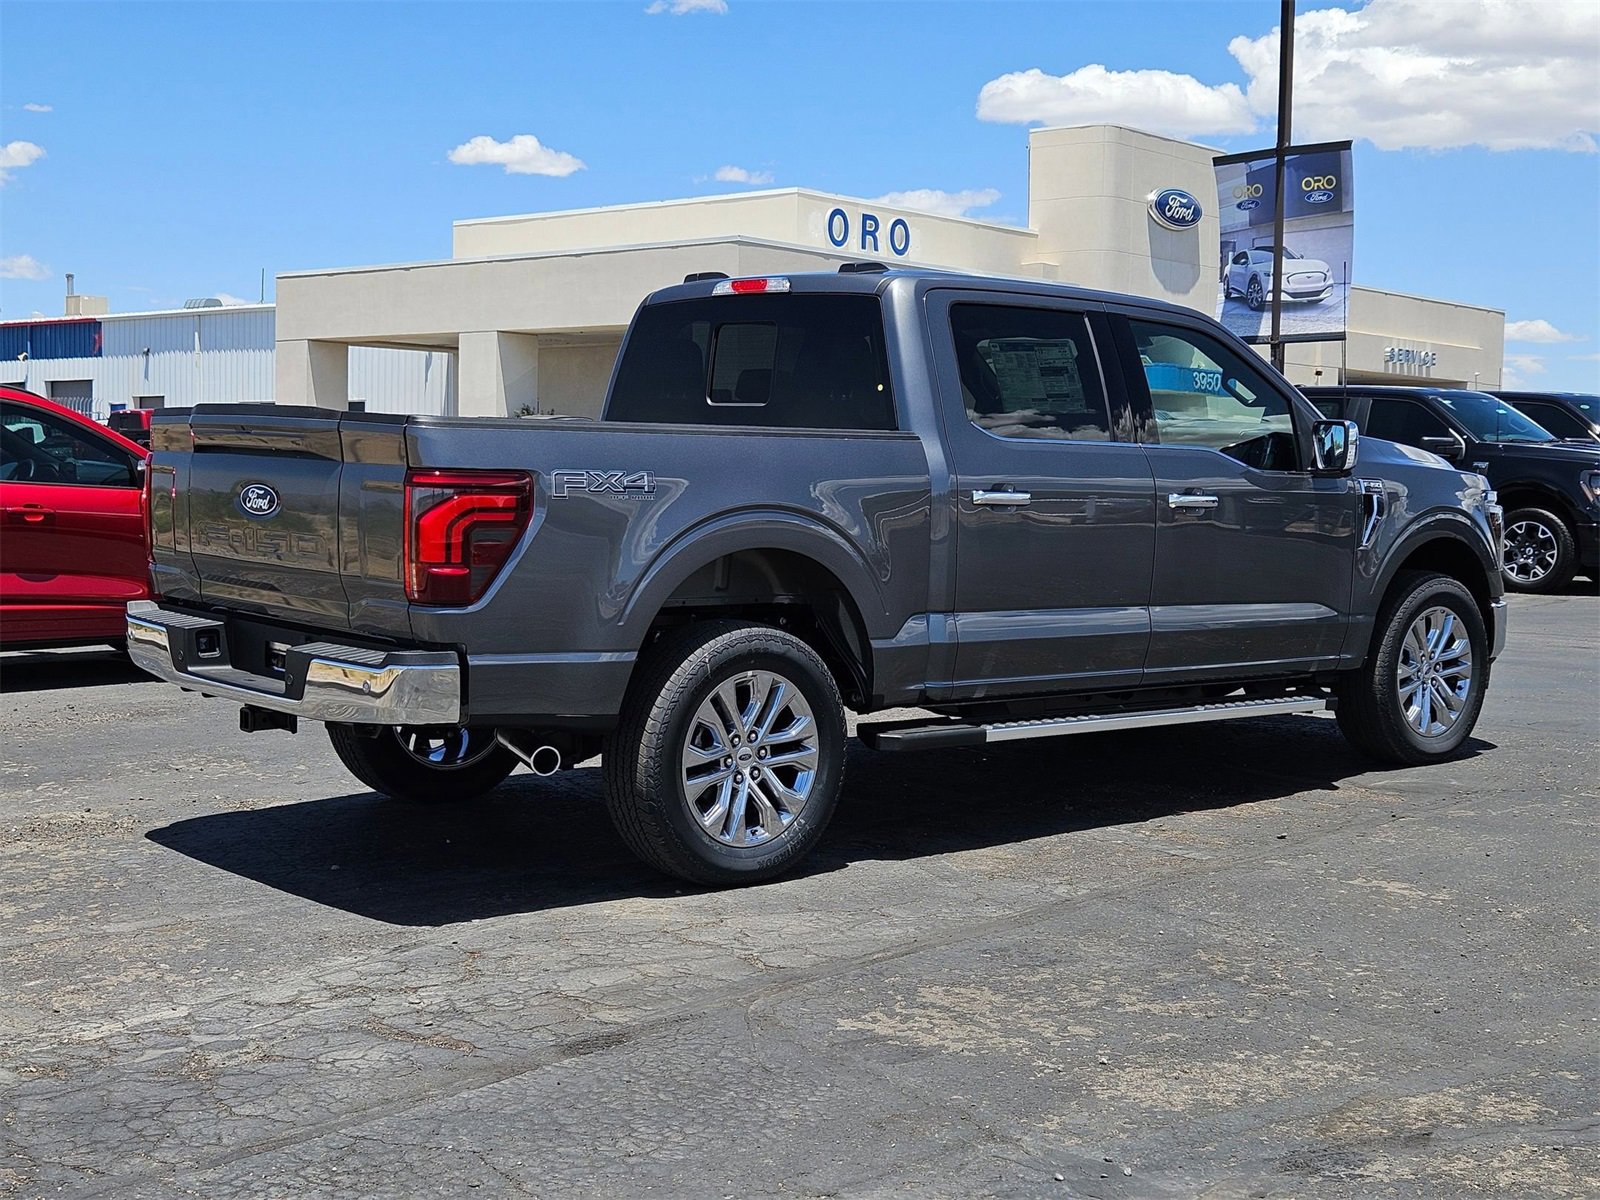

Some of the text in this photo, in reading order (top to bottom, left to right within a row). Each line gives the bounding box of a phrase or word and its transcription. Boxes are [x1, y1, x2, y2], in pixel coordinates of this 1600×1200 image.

[1232, 183, 1263, 199] ORO
[1302, 175, 1336, 191] ORO
[1164, 194, 1196, 221] Ford
[827, 208, 910, 256] ORO
[1384, 347, 1437, 367] SERVICE
[1193, 371, 1221, 391] 3950
[551, 470, 656, 498] FX4
[245, 487, 271, 511] Ford
[198, 521, 328, 562] F-150
